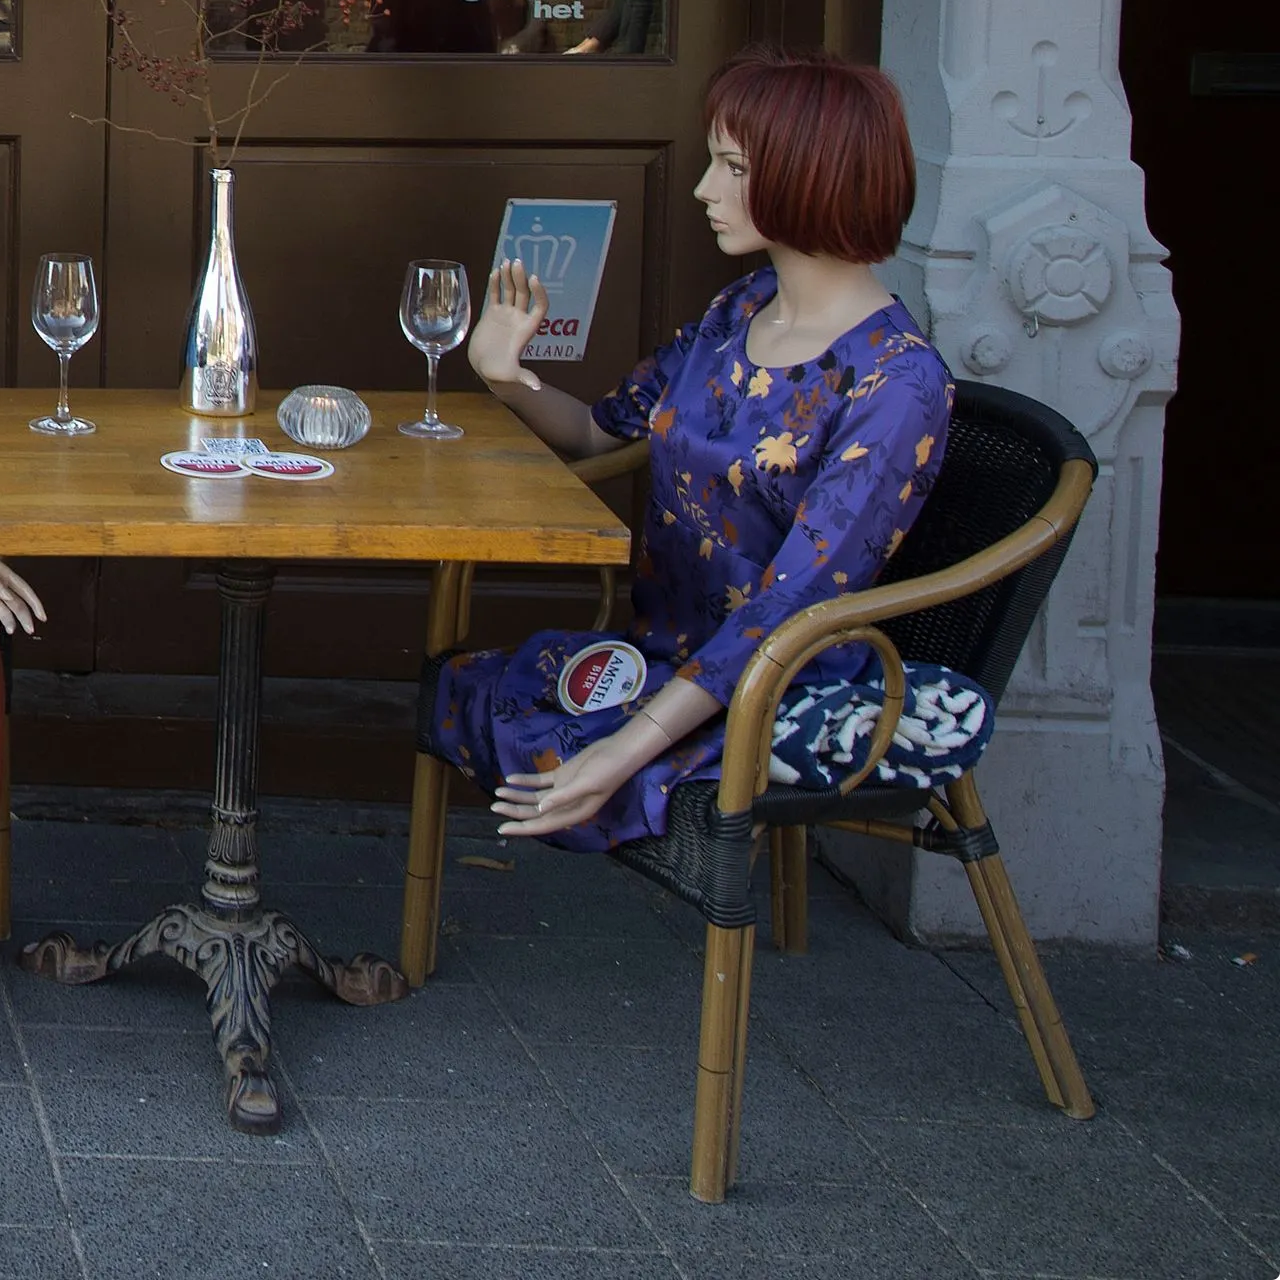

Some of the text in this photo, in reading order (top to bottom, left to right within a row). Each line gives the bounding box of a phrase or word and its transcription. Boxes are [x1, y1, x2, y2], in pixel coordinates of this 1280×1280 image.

[533, 0, 584, 19] het
[536, 318, 580, 337] eca
[525, 344, 575, 358] RLAND
[582, 664, 602, 689] BIER
[590, 655, 624, 705] AMSTEL
